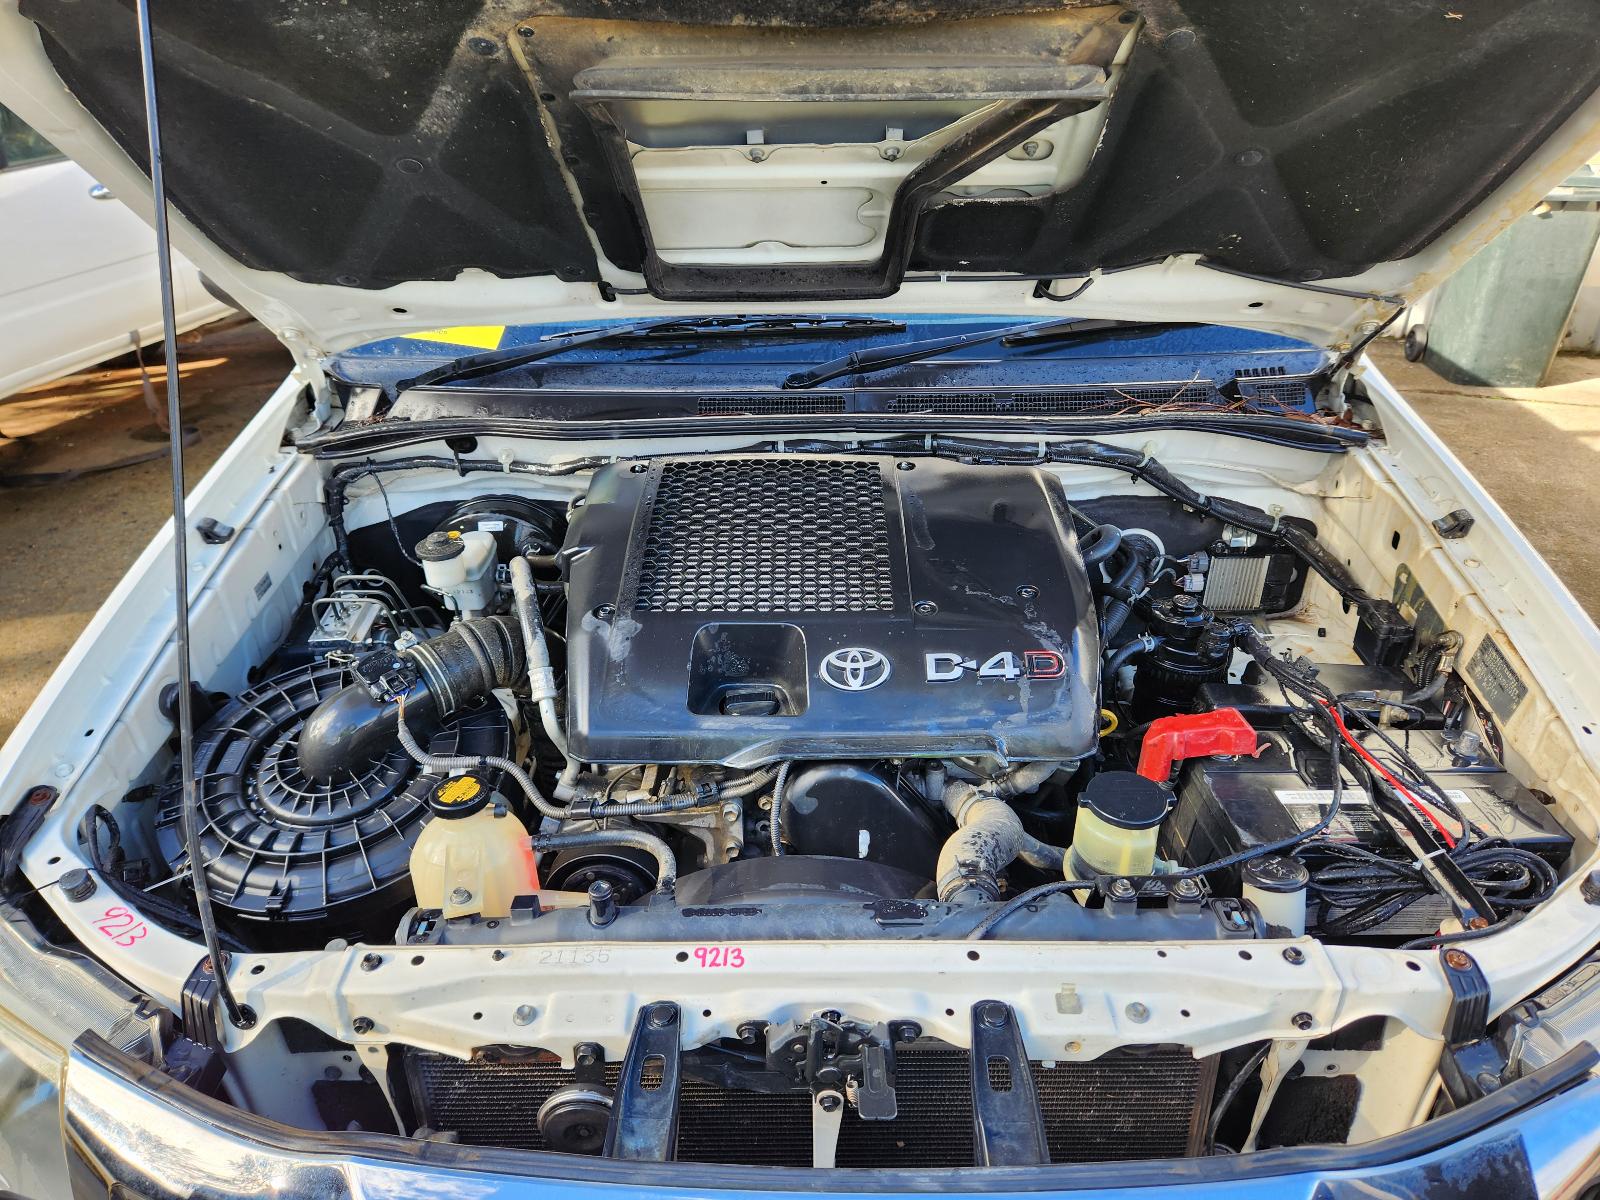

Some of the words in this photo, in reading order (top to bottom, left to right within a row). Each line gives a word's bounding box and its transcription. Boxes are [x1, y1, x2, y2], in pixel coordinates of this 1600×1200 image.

[925, 651, 1065, 683] D-4D
[92, 906, 147, 947] 9213
[694, 946, 745, 968] 9213
